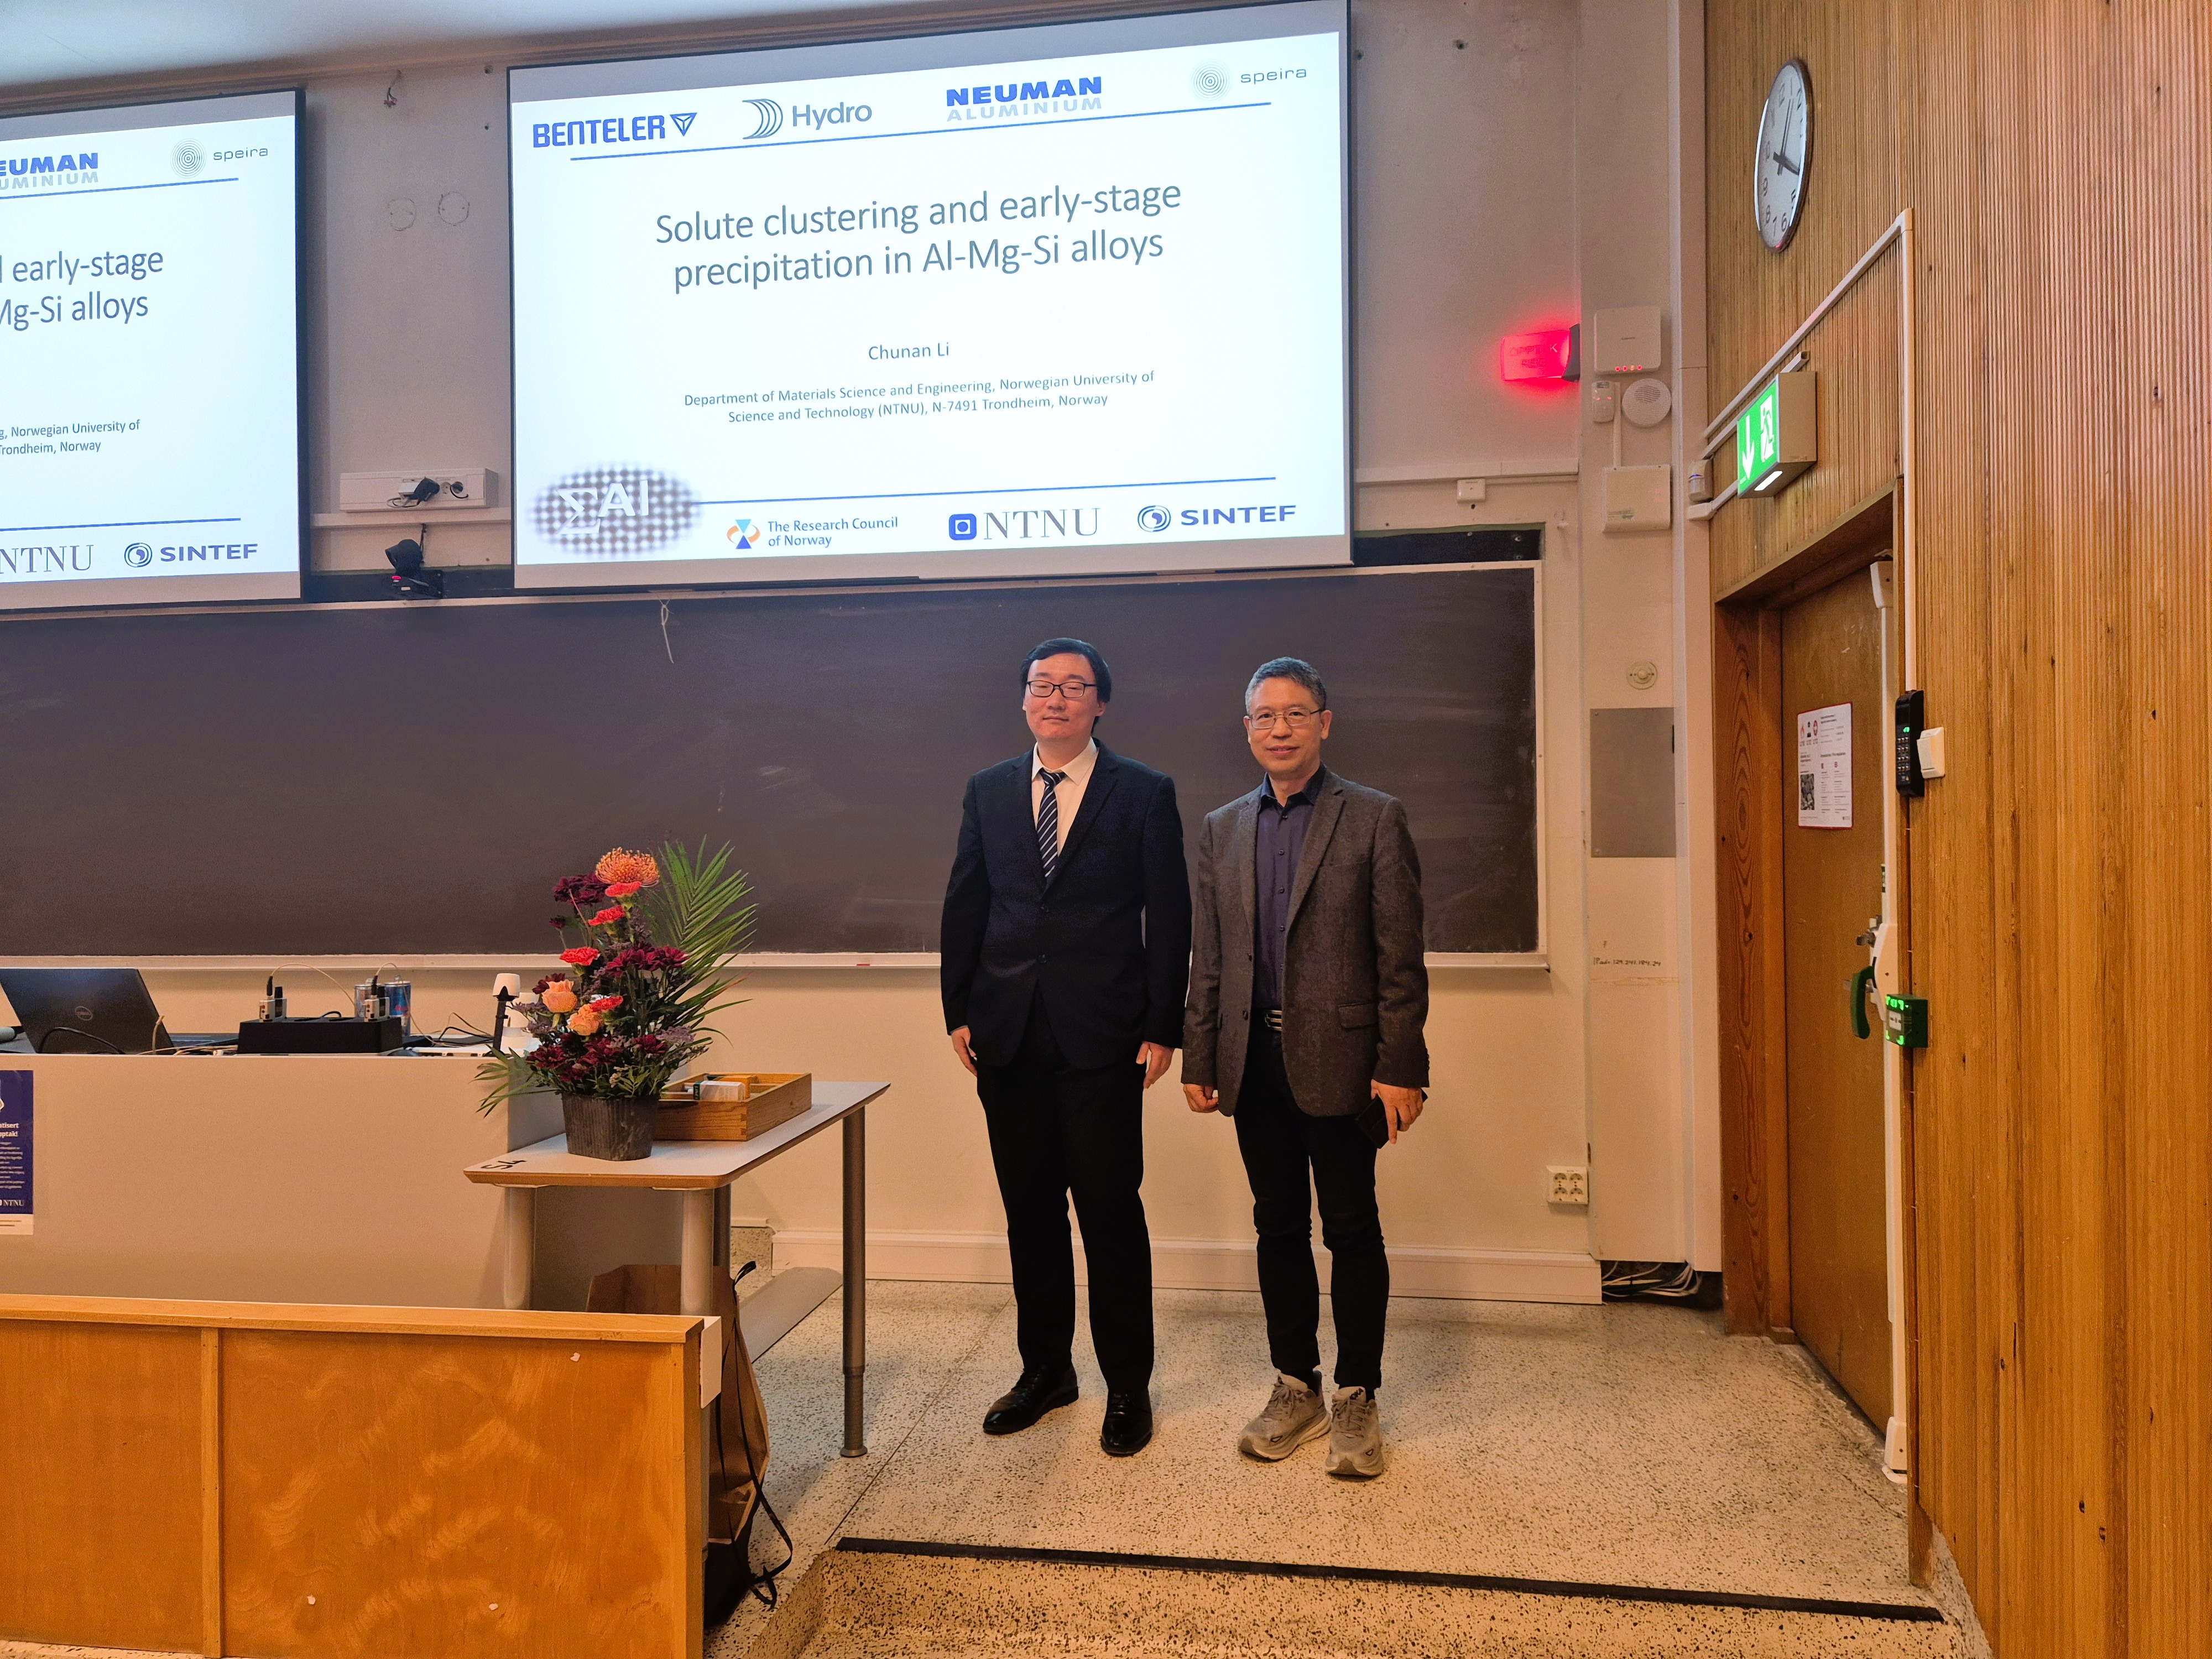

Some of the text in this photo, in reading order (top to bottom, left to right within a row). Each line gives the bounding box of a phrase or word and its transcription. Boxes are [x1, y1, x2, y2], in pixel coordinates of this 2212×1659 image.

[1240, 67, 1307, 85] speira
[946, 76, 1102, 107] NEUMAN
[792, 102, 873, 131] Hydro
[947, 97, 1102, 122] ALUMINIUM
[533, 115, 665, 148] BENTELER
[213, 147, 269, 162] speira
[656, 185, 1181, 244] Solute clustering and early-stage
[12, 251, 164, 285] early-stage
[675, 229, 1164, 295] precipitation in Al-Mg-Si alloys
[71, 291, 149, 324] alloys
[868, 342, 950, 361] Chunan Li
[685, 370, 1155, 408] Department of Materials Science and Engineering, Norwegian University of
[728, 393, 1108, 423] Science and Technology (NTNU), N-7491 Trondheim, Norway
[11, 424, 69, 438] Norwegian
[72, 420, 126, 435] University
[129, 419, 141, 431] of
[60, 441, 102, 453] Norway
[768, 517, 898, 533] The Research Council
[983, 507, 1100, 540] NTNU
[1181, 505, 1297, 526] SINTEF
[160, 543, 258, 562] SINTEF
[768, 534, 832, 549] of Norway
[0, 545, 94, 574] NTNU
